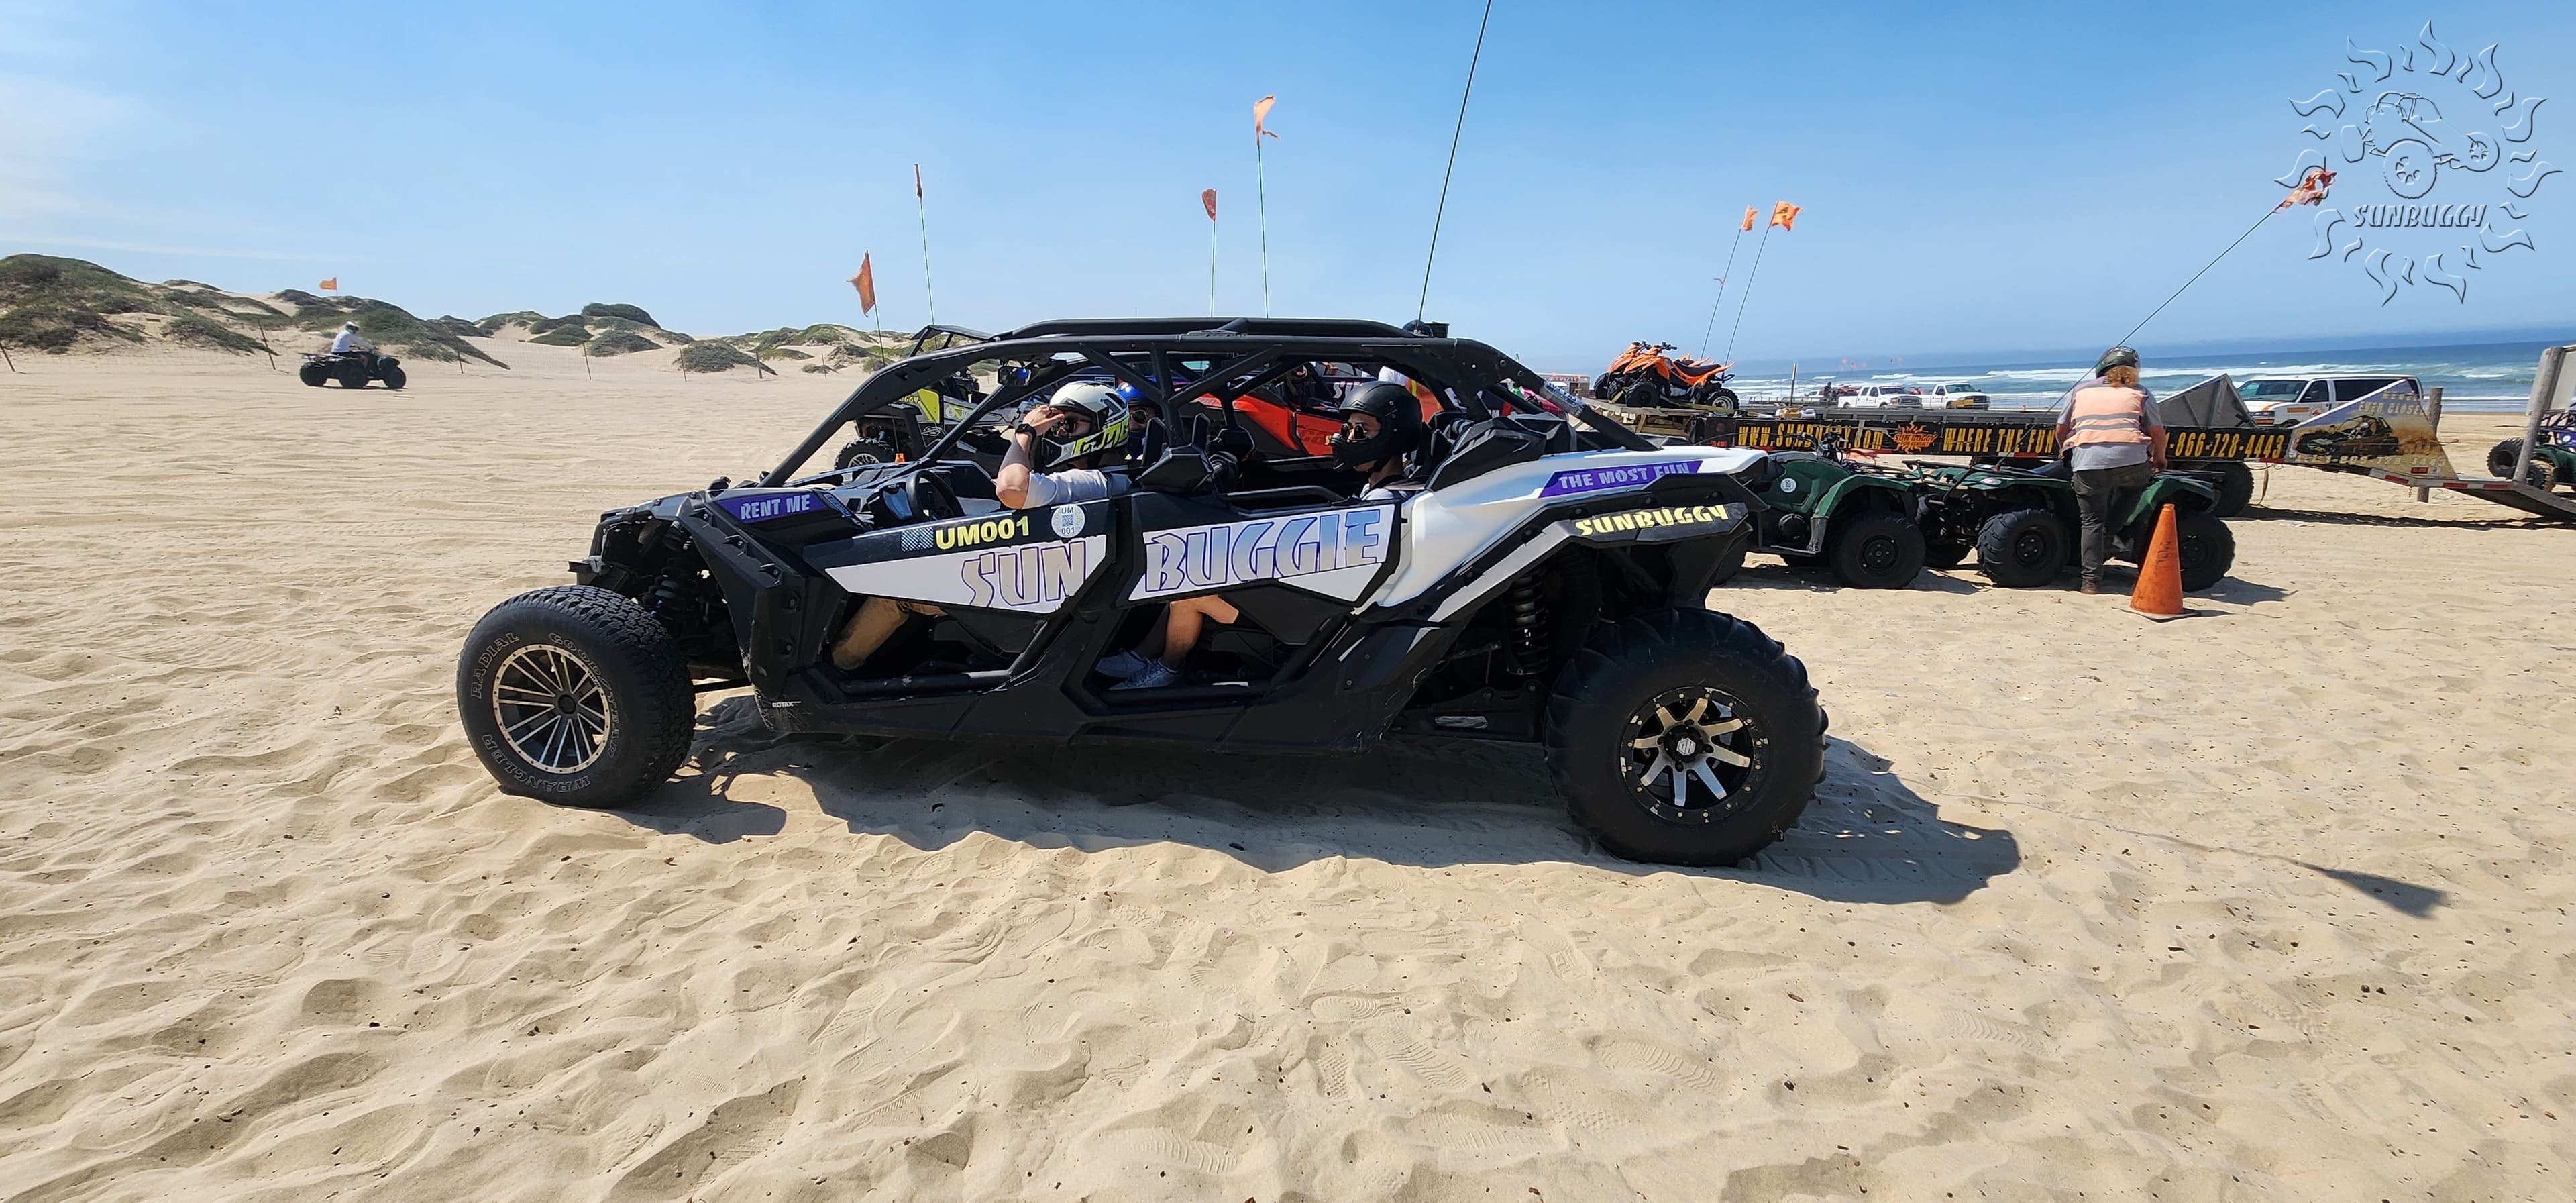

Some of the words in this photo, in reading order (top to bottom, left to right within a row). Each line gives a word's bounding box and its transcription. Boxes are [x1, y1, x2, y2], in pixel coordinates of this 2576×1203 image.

[1943, 427, 1993, 452] WHERE
[1996, 429, 2023, 453] THE
[2026, 429, 2056, 454] FUN
[1559, 473, 1594, 489] THE
[1598, 468, 1648, 484] MOST
[1655, 463, 1690, 478] FUN
[741, 499, 780, 519] RENT
[786, 494, 810, 513] ME
[1061, 507, 1075, 515] UM
[1575, 504, 1729, 536] SUNBUGGY
[936, 515, 1030, 550] UM001
[1061, 527, 1075, 535] 001
[961, 541, 1086, 607] SUN
[1144, 509, 1381, 593] BUGGIE
[471, 632, 520, 699] RADIAL
[482, 734, 591, 792] WRANGLER
